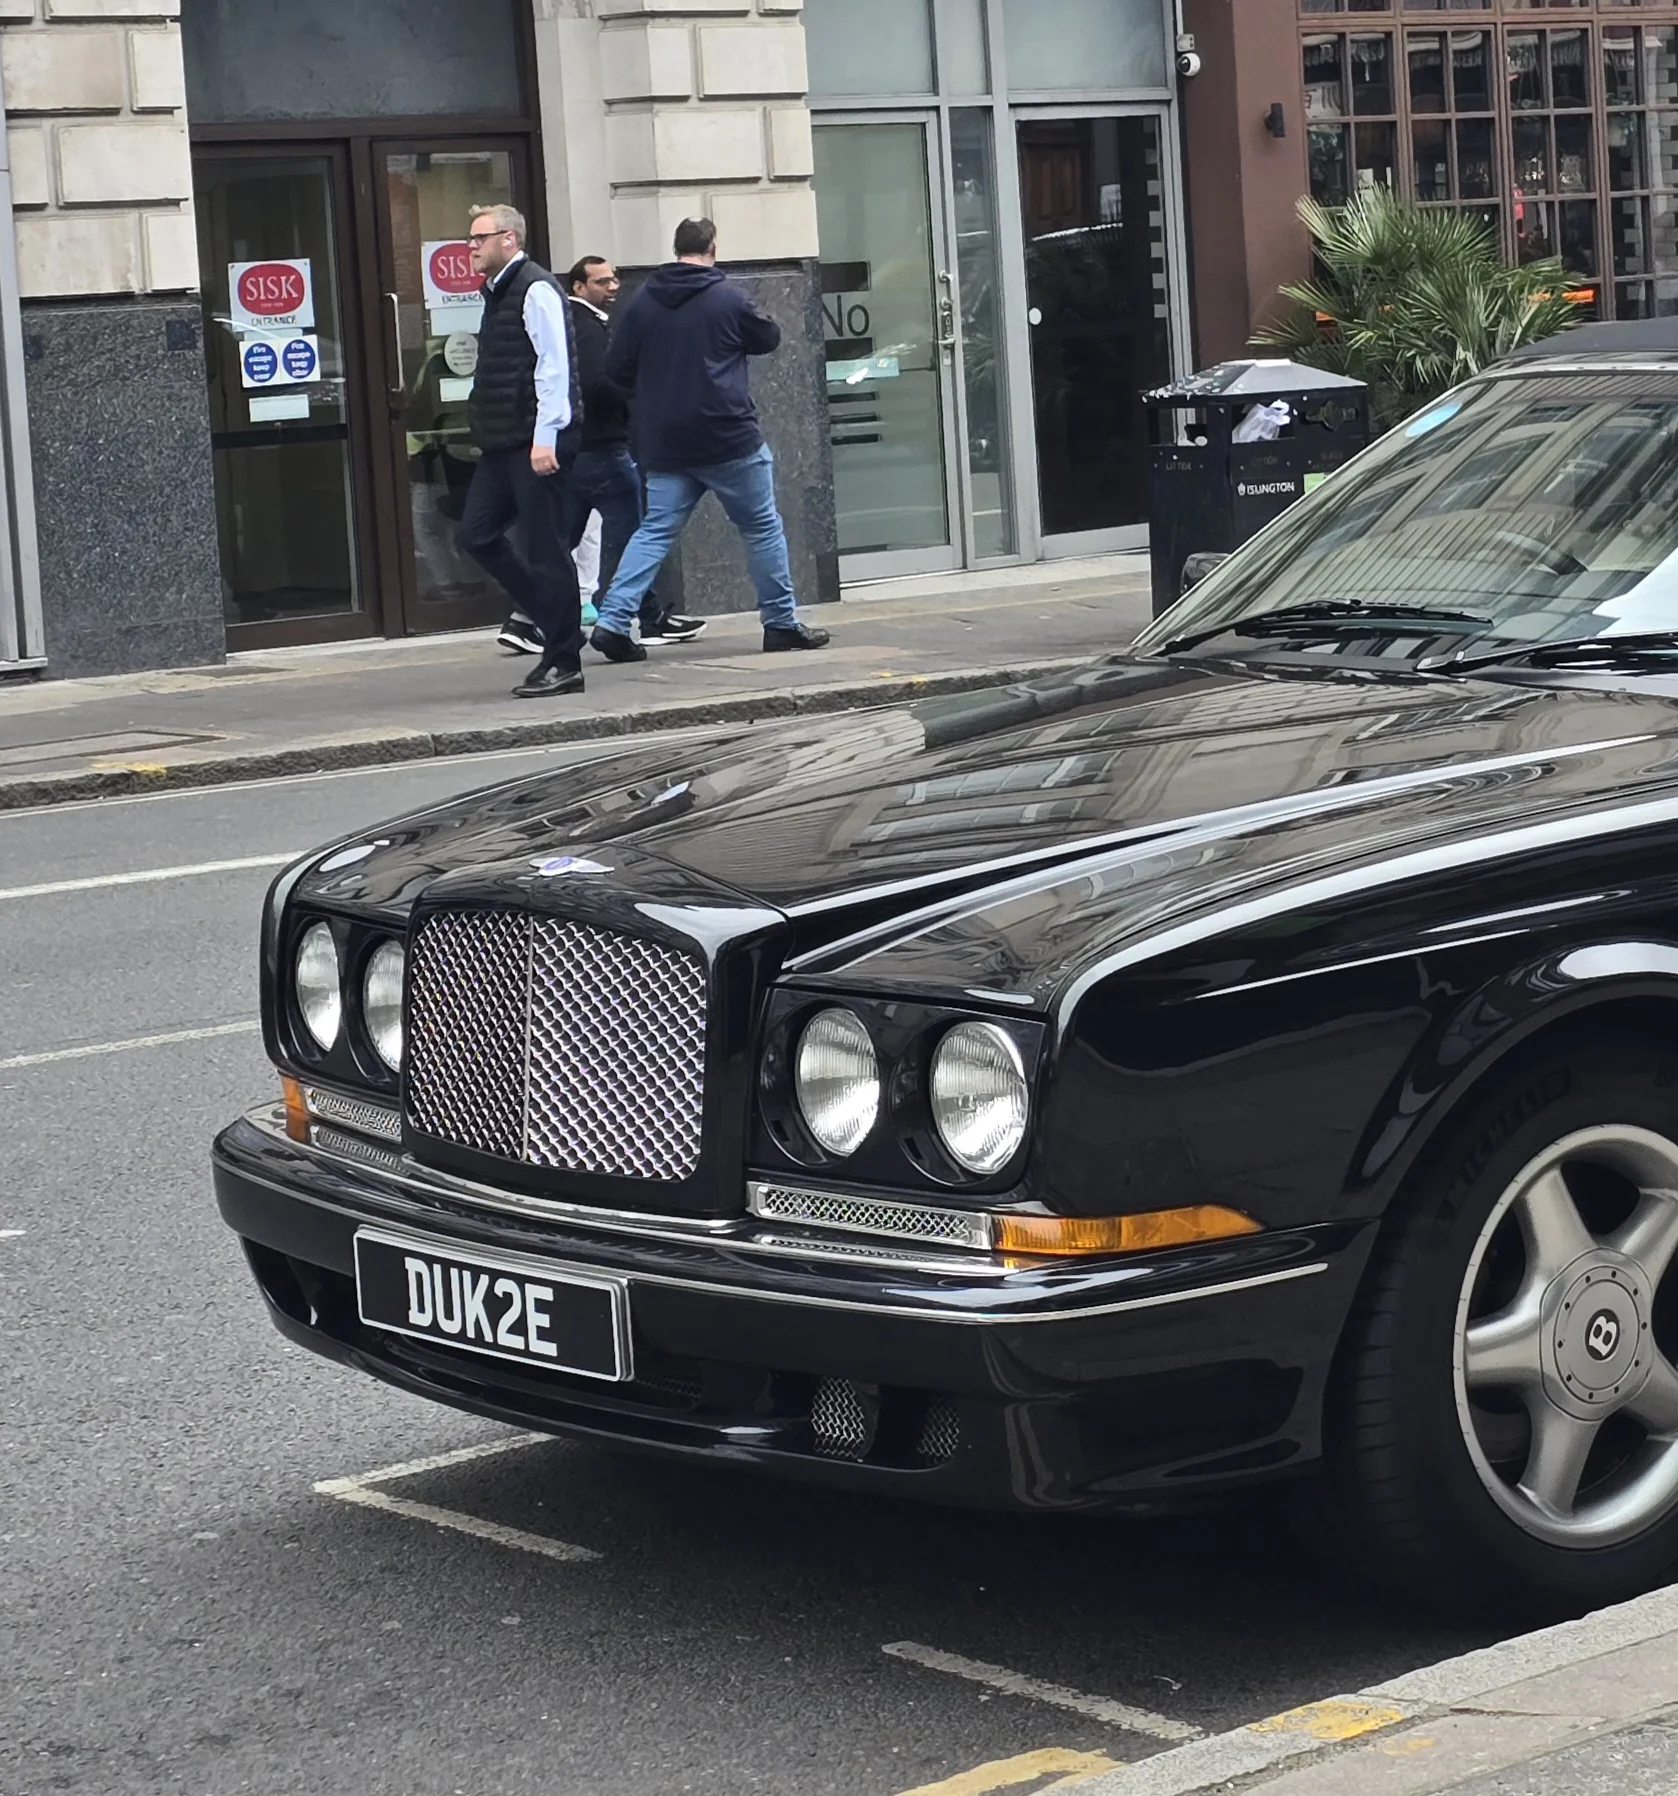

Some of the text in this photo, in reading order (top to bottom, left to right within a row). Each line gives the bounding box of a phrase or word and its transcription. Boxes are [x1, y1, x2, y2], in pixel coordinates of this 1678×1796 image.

[245, 275, 299, 301] SISK
[821, 294, 870, 337] No
[1246, 481, 1295, 495] ISLINGTON
[404, 1256, 558, 1357] DUK2E
[1589, 1315, 1617, 1356] B
